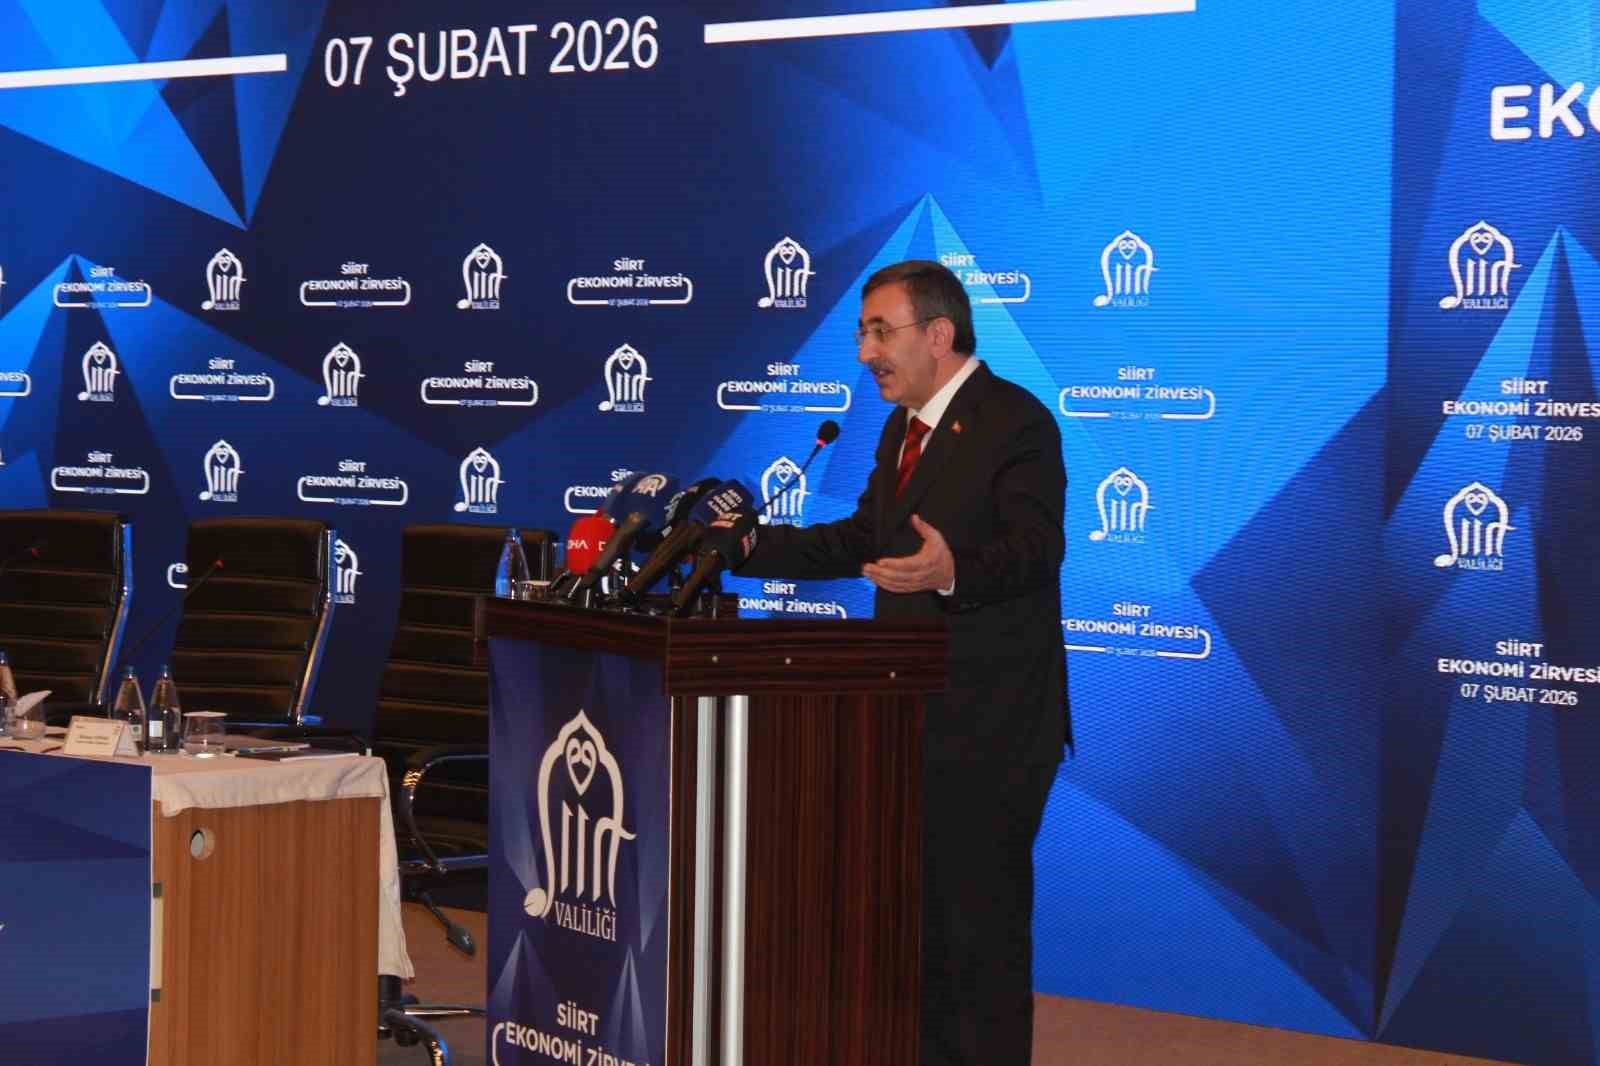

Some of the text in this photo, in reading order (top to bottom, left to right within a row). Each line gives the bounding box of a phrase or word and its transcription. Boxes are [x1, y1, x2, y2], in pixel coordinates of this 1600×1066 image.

[324, 15, 659, 97] 07 ŞUBAT 2026
[1490, 81, 1600, 141] EK
[308, 277, 402, 291] EKONOMİ ZİRVESİ
[576, 272, 683, 288] EKONOMİ ZİRVESİ
[965, 269, 1018, 286] ZİRVESİ
[178, 373, 266, 386] EKONOMİ ZİRVESİ
[429, 375, 529, 390] EKONOMİ ZİRVESİ
[727, 379, 840, 394] EKONOMİ ZİRVESİ
[1070, 386, 1203, 400] EKONOMİ ZİRVESİ
[1442, 398, 1600, 417] EKONOMİ ZİRVES
[1465, 423, 1584, 442] 07 ŞUBAT 2026
[57, 466, 142, 479] EKONOMİ ZİRVESİ
[305, 475, 400, 490] EKONOMİ ZİRVESİ
[785, 599, 836, 615] ZİRVESİ
[1066, 618, 1199, 641] EKONOMİ ZİRVESİ
[1437, 657, 1525, 678] EKONOMİ
[1460, 683, 1579, 706] 07 ŞUBAT 2026
[554, 899, 617, 942] VALİLİĞİ
[556, 1000, 599, 1036] SİİRT
[505, 1020, 582, 1066] EKONOMİ
